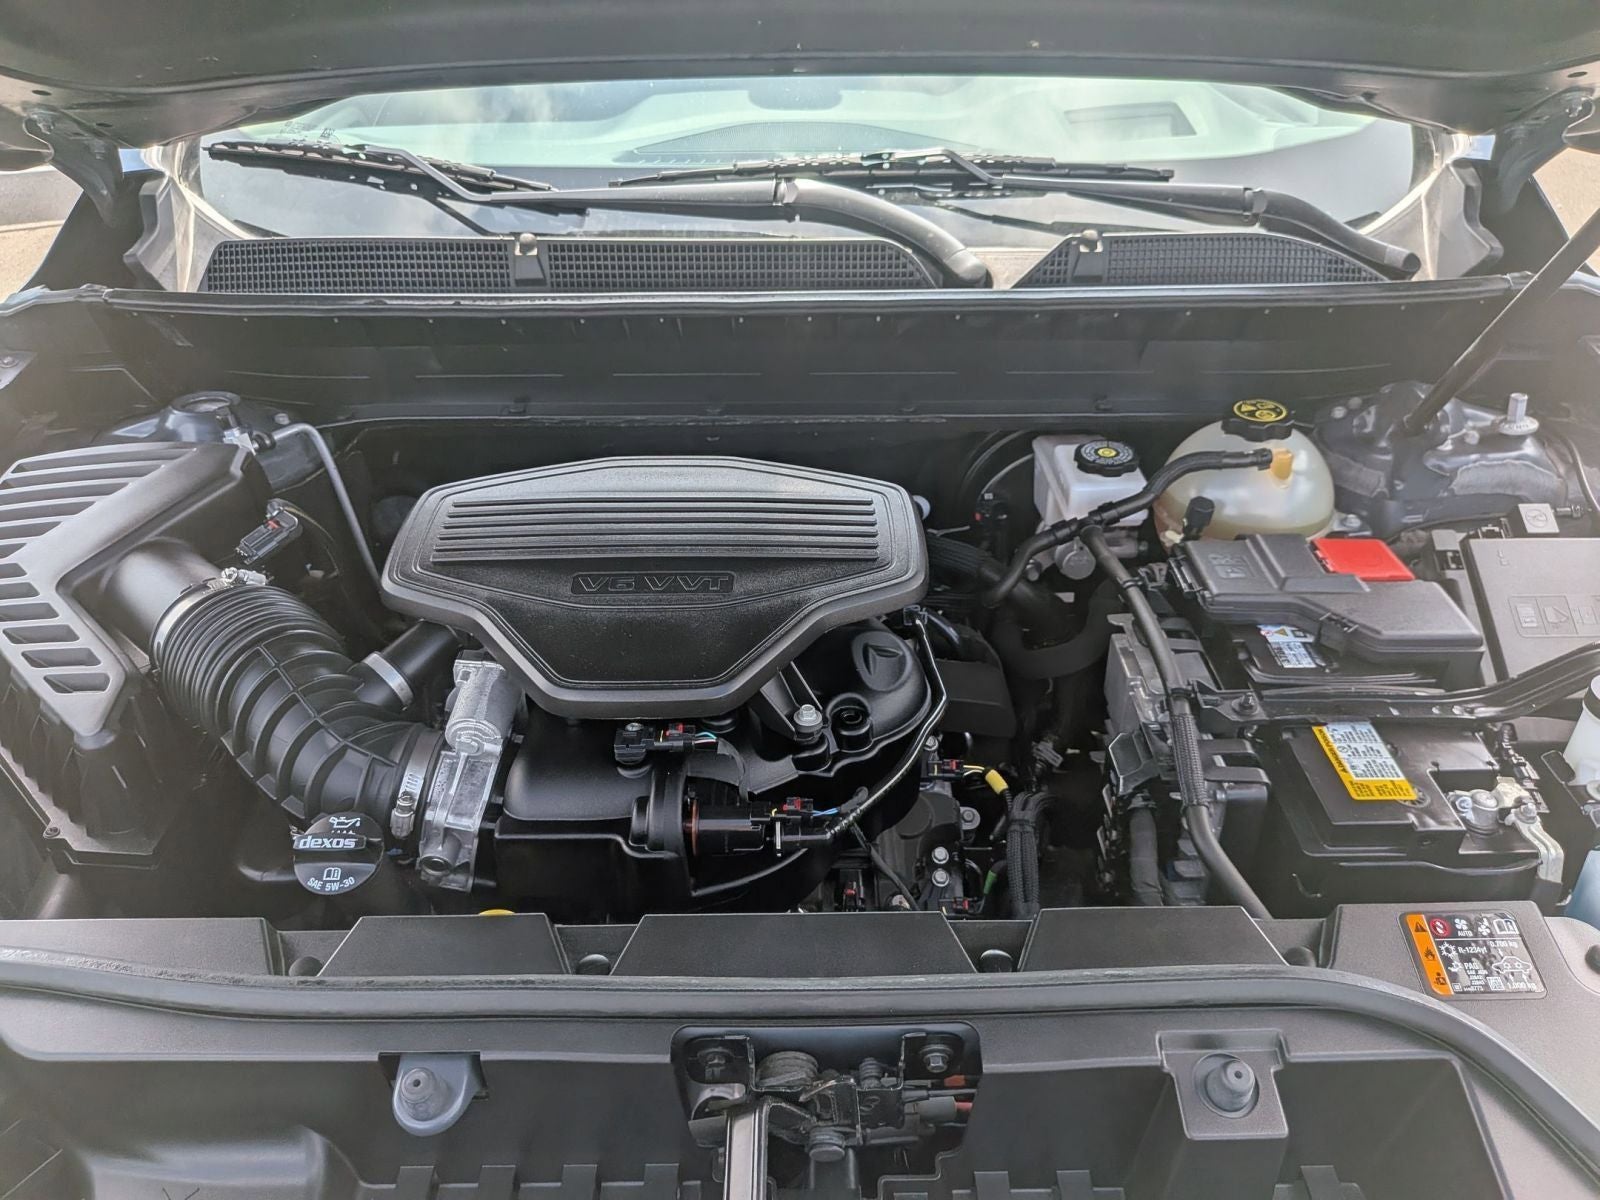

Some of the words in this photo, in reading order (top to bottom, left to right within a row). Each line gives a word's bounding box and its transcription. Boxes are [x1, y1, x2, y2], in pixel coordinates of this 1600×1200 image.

[578, 576, 635, 591] V6
[644, 575, 729, 591] VVT
[299, 835, 359, 849] dexos
[307, 877, 324, 890] SAE
[325, 876, 356, 892] 5W-30
